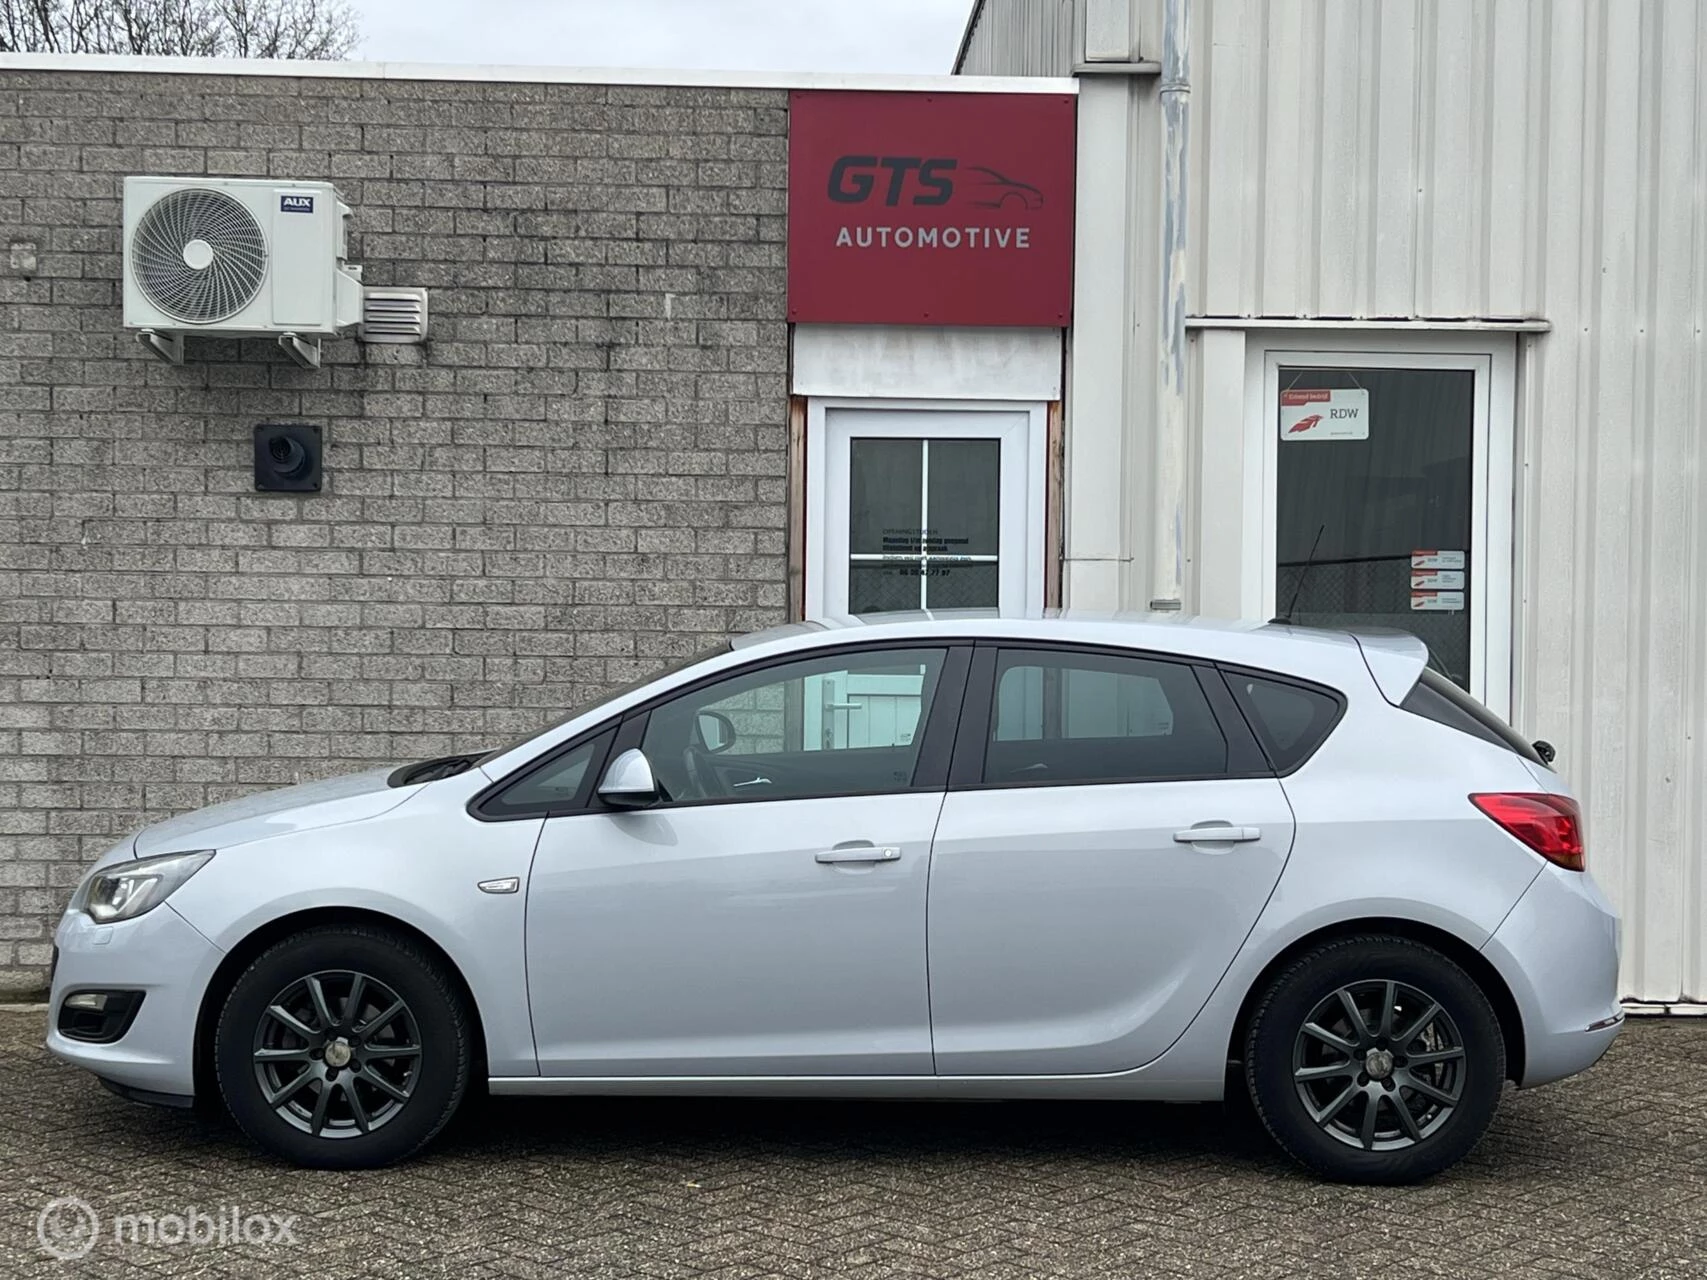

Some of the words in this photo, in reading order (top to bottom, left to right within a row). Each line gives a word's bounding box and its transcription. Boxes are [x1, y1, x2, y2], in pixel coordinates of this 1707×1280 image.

[828, 155, 957, 206] GTS
[282, 197, 311, 207] AUX
[837, 227, 1030, 249] AUTOMOTIVE
[1330, 409, 1359, 418] RDW
